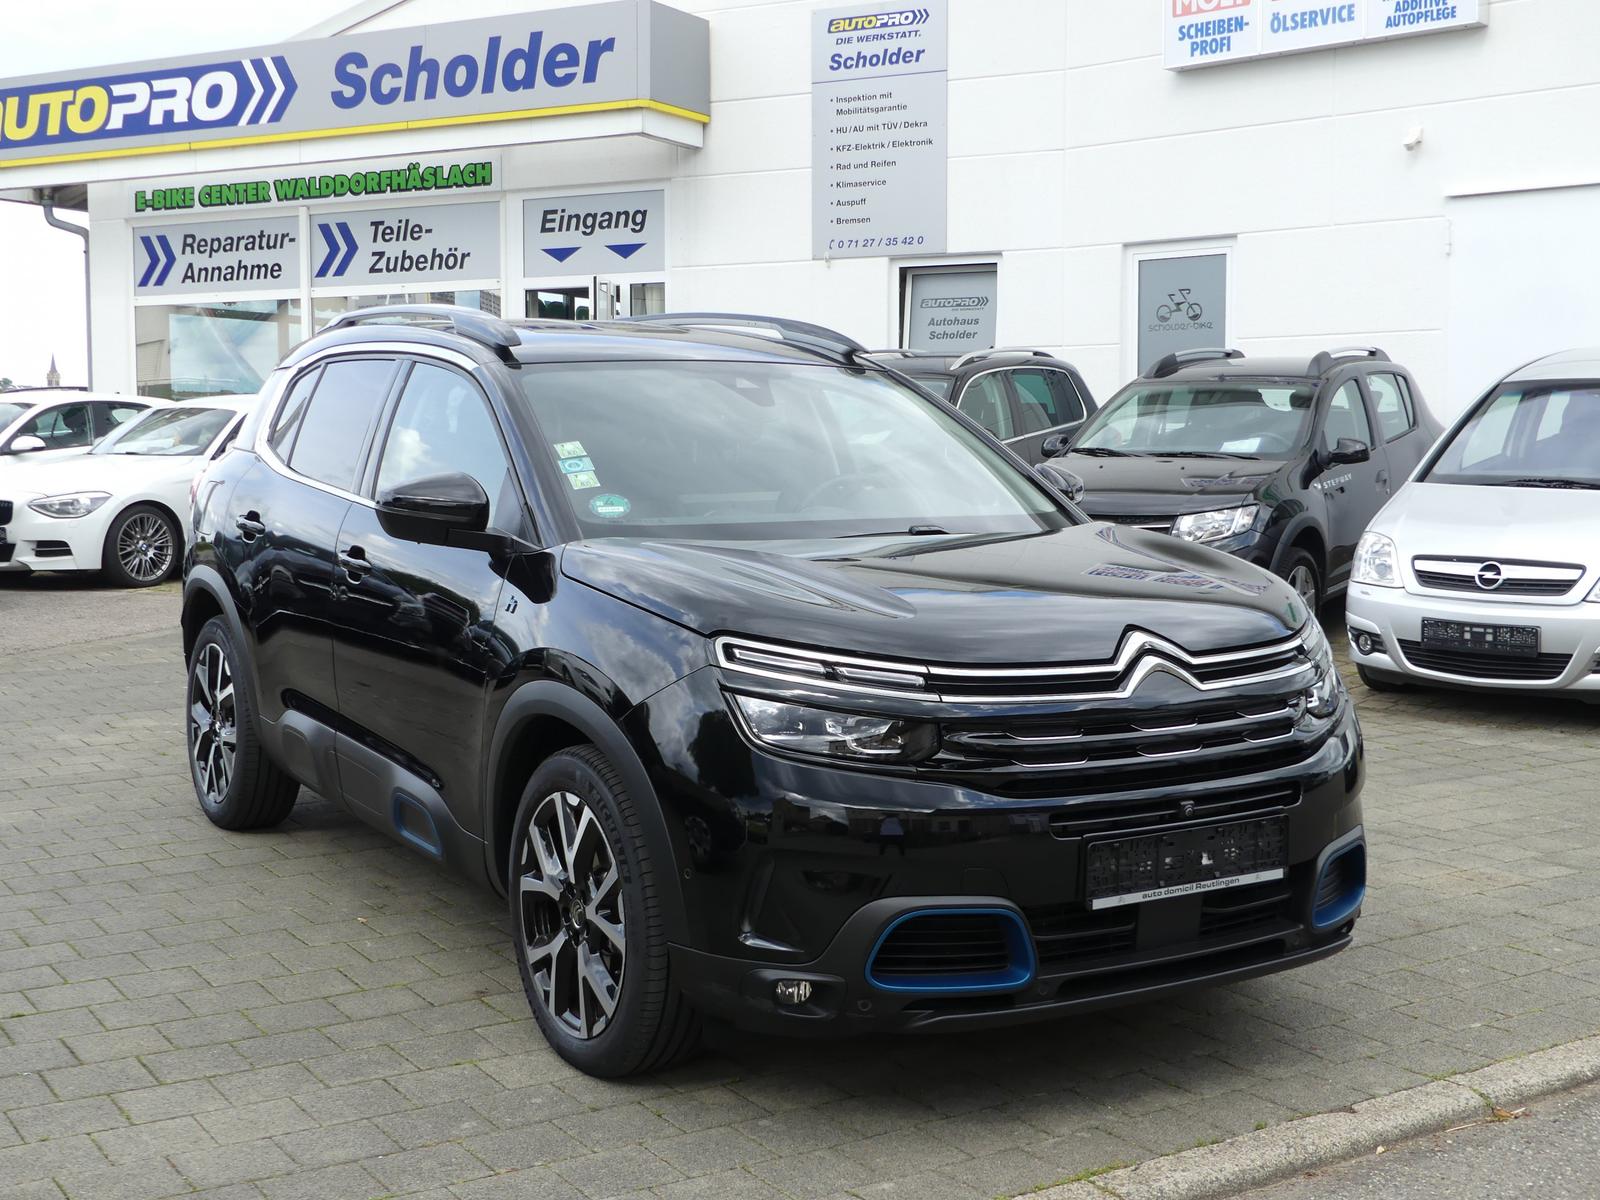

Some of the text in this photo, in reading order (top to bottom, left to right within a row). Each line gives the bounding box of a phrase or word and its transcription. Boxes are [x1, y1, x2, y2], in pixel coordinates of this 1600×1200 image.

[1270, 4, 1355, 33] ÖLSERVICE
[1385, 6, 1456, 28] AUTOPFLEGE
[1178, 15, 1249, 41] SCHEIBEN-
[835, 36, 854, 46] DIE
[1190, 36, 1231, 57] PROFI
[829, 47, 925, 71] Scholder
[331, 31, 615, 109] Scholder
[0, 71, 238, 142] UTOPRO
[836, 91, 892, 104] Inspektion mit
[836, 103, 908, 116] Mobilitätsgarantie
[866, 124, 880, 132] mit
[836, 160, 897, 170] Rad und Reifen
[135, 161, 492, 212] E-BIKE CENTER WALDDORFHÄSLACH
[836, 179, 887, 189] Klimaservice
[836, 198, 866, 207] Auspuff
[369, 219, 433, 244] Teile-
[540, 207, 648, 237] Eingang
[836, 217, 871, 225] Bremsen
[181, 230, 297, 258] Reparatur-
[368, 248, 471, 274] Zubehör
[181, 260, 282, 284] Annahme
[927, 316, 980, 326] Autohaus
[928, 330, 978, 340] Scholder
[1142, 878, 1240, 899] auto domicil Reutlingen
